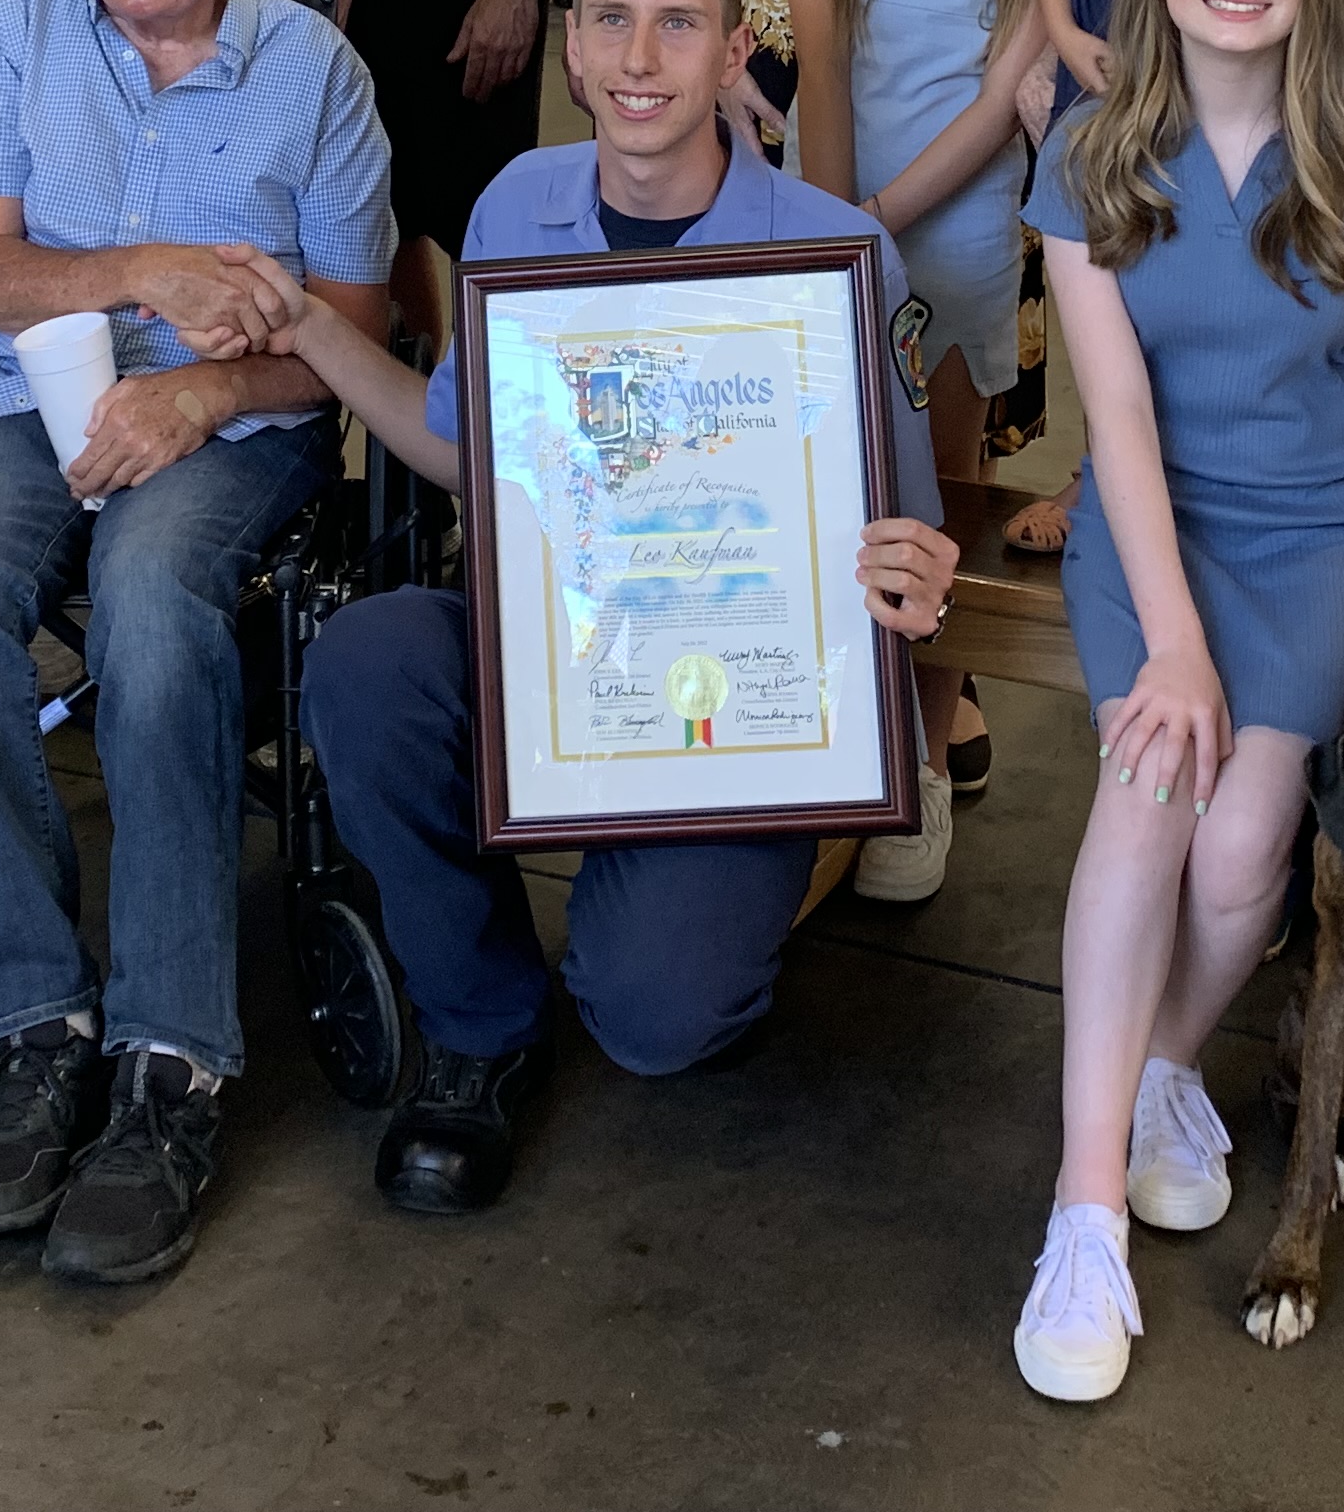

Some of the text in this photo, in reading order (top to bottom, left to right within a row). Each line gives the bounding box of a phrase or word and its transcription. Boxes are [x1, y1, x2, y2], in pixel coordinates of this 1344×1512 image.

[668, 372, 775, 414] Angeles
[696, 412, 777, 438] California
[617, 470, 761, 514] Certificate of Recognition
[655, 497, 679, 517] hereby
[678, 497, 718, 519] presented
[629, 526, 757, 584] Leo Kaufman
